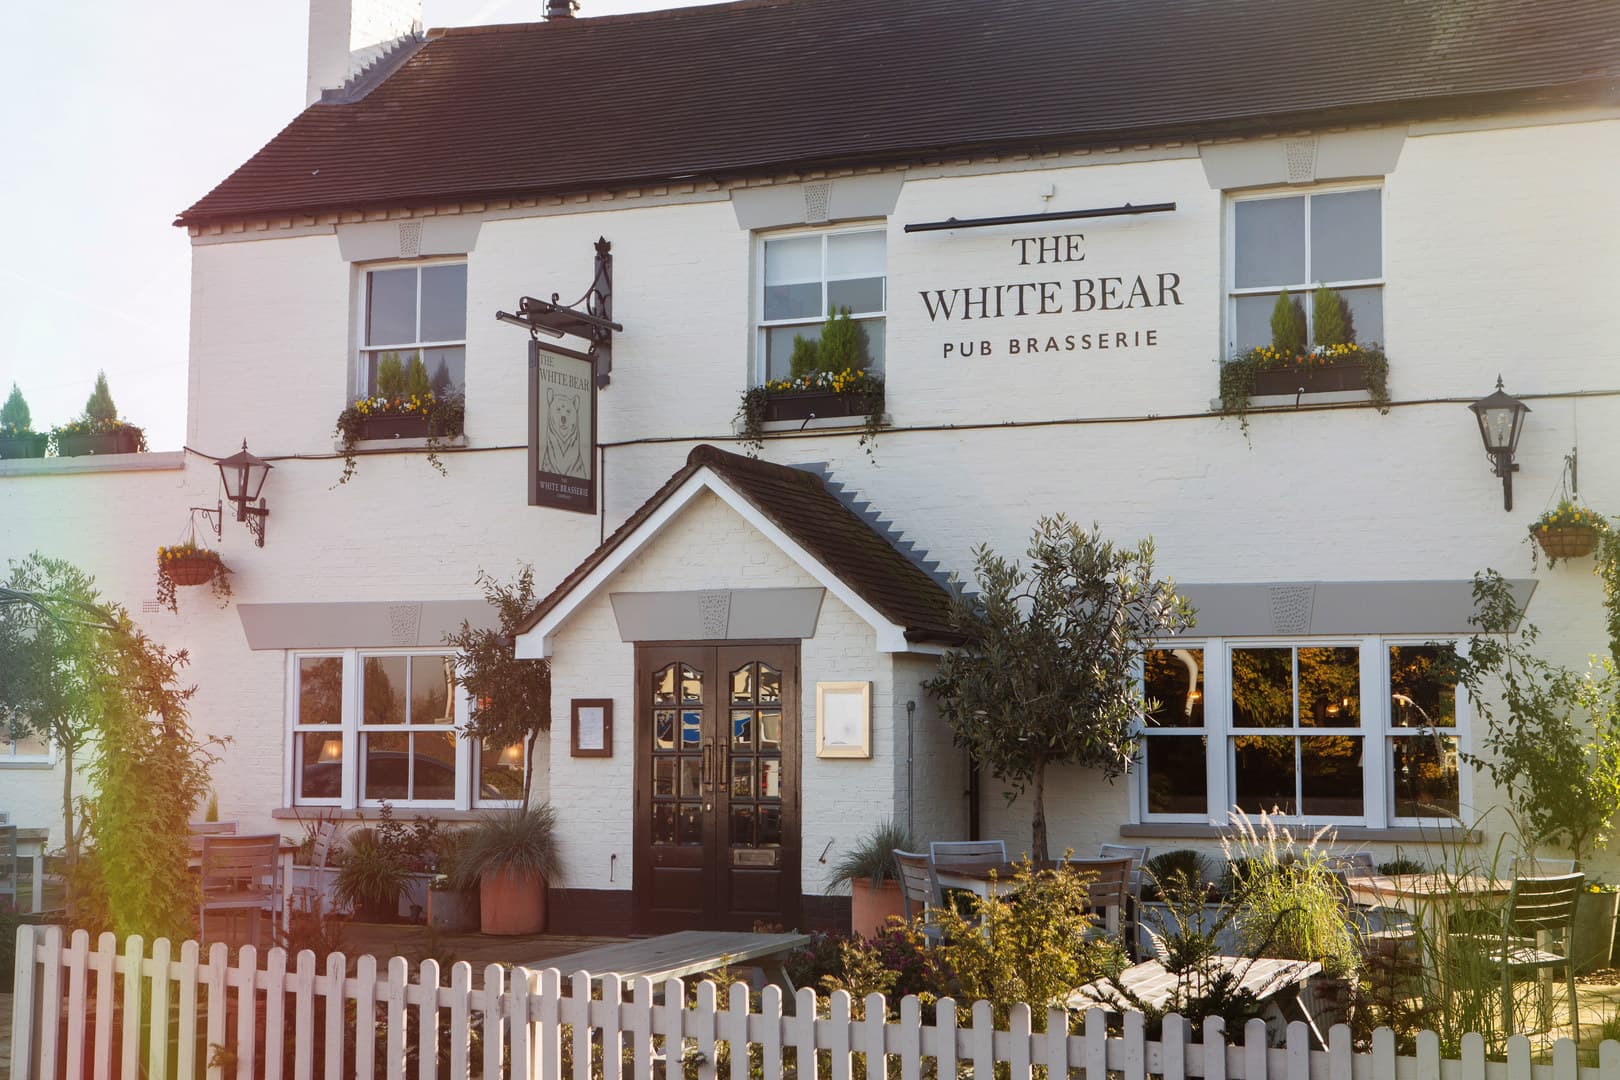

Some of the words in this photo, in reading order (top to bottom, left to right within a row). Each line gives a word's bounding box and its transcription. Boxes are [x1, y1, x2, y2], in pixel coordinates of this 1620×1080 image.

[1011, 234, 1086, 266] THE
[918, 281, 1063, 322] WHITE
[1072, 272, 1185, 313] BEAR
[943, 341, 992, 359] PUB
[1009, 330, 1158, 355] BRASSERIE
[540, 354, 554, 367] THE
[539, 367, 568, 385] WHITE
[569, 375, 589, 392] BEAR
[539, 480, 559, 491] WHITE
[560, 484, 588, 497] BRASSERIE
